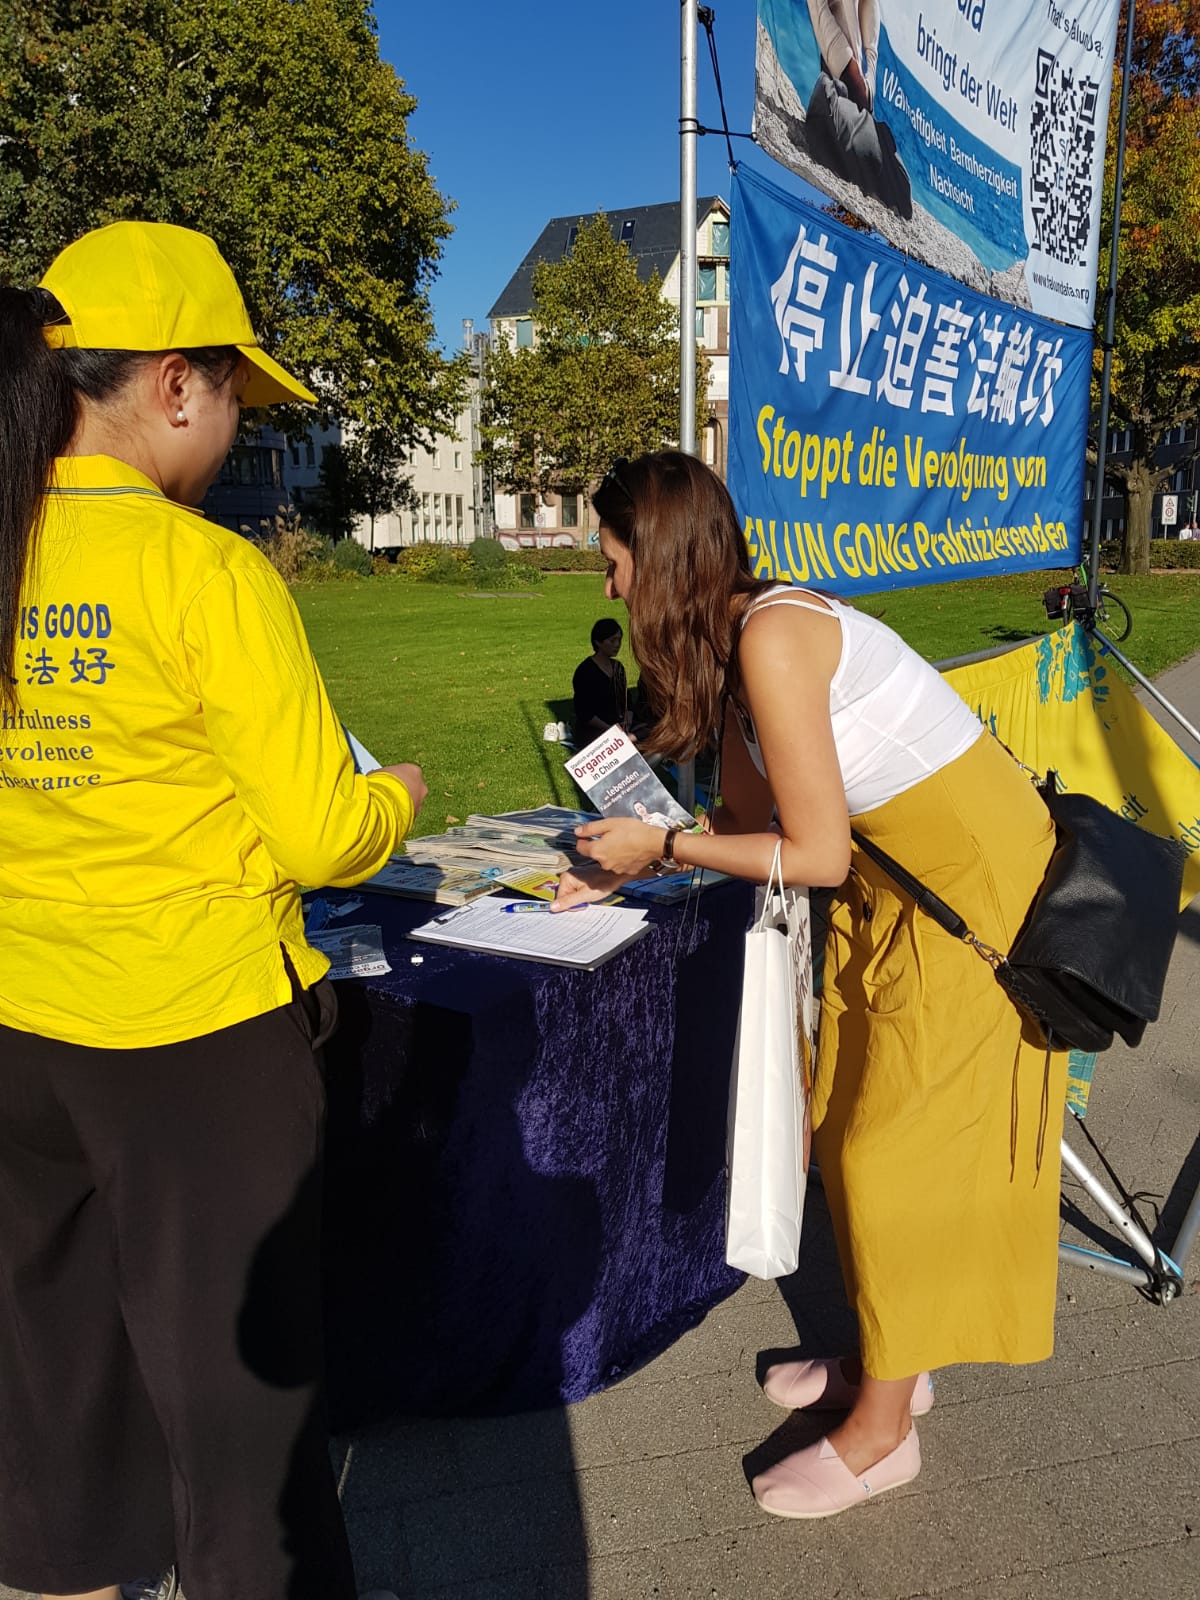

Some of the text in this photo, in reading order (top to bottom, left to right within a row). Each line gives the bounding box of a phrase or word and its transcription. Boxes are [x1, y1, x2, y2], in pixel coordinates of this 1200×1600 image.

[917, 12, 957, 92] bringt
[960, 62, 982, 108] der
[987, 80, 1018, 133] Welt
[930, 163, 975, 214] Nachsicht
[950, 136, 1018, 199] Barmherzigkeit
[770, 224, 1063, 427] 停止迫害法輪功
[757, 405, 854, 499] Stoppt
[858, 426, 898, 488] die
[1012, 455, 1046, 488] von
[744, 513, 1070, 583] FALUN GONG Praktizierenden
[20, 603, 112, 639] IS GOOD
[10, 646, 116, 685] 法好
[574, 737, 625, 778] Organraub
[592, 758, 620, 781] in China
[607, 771, 640, 797] lebenden
